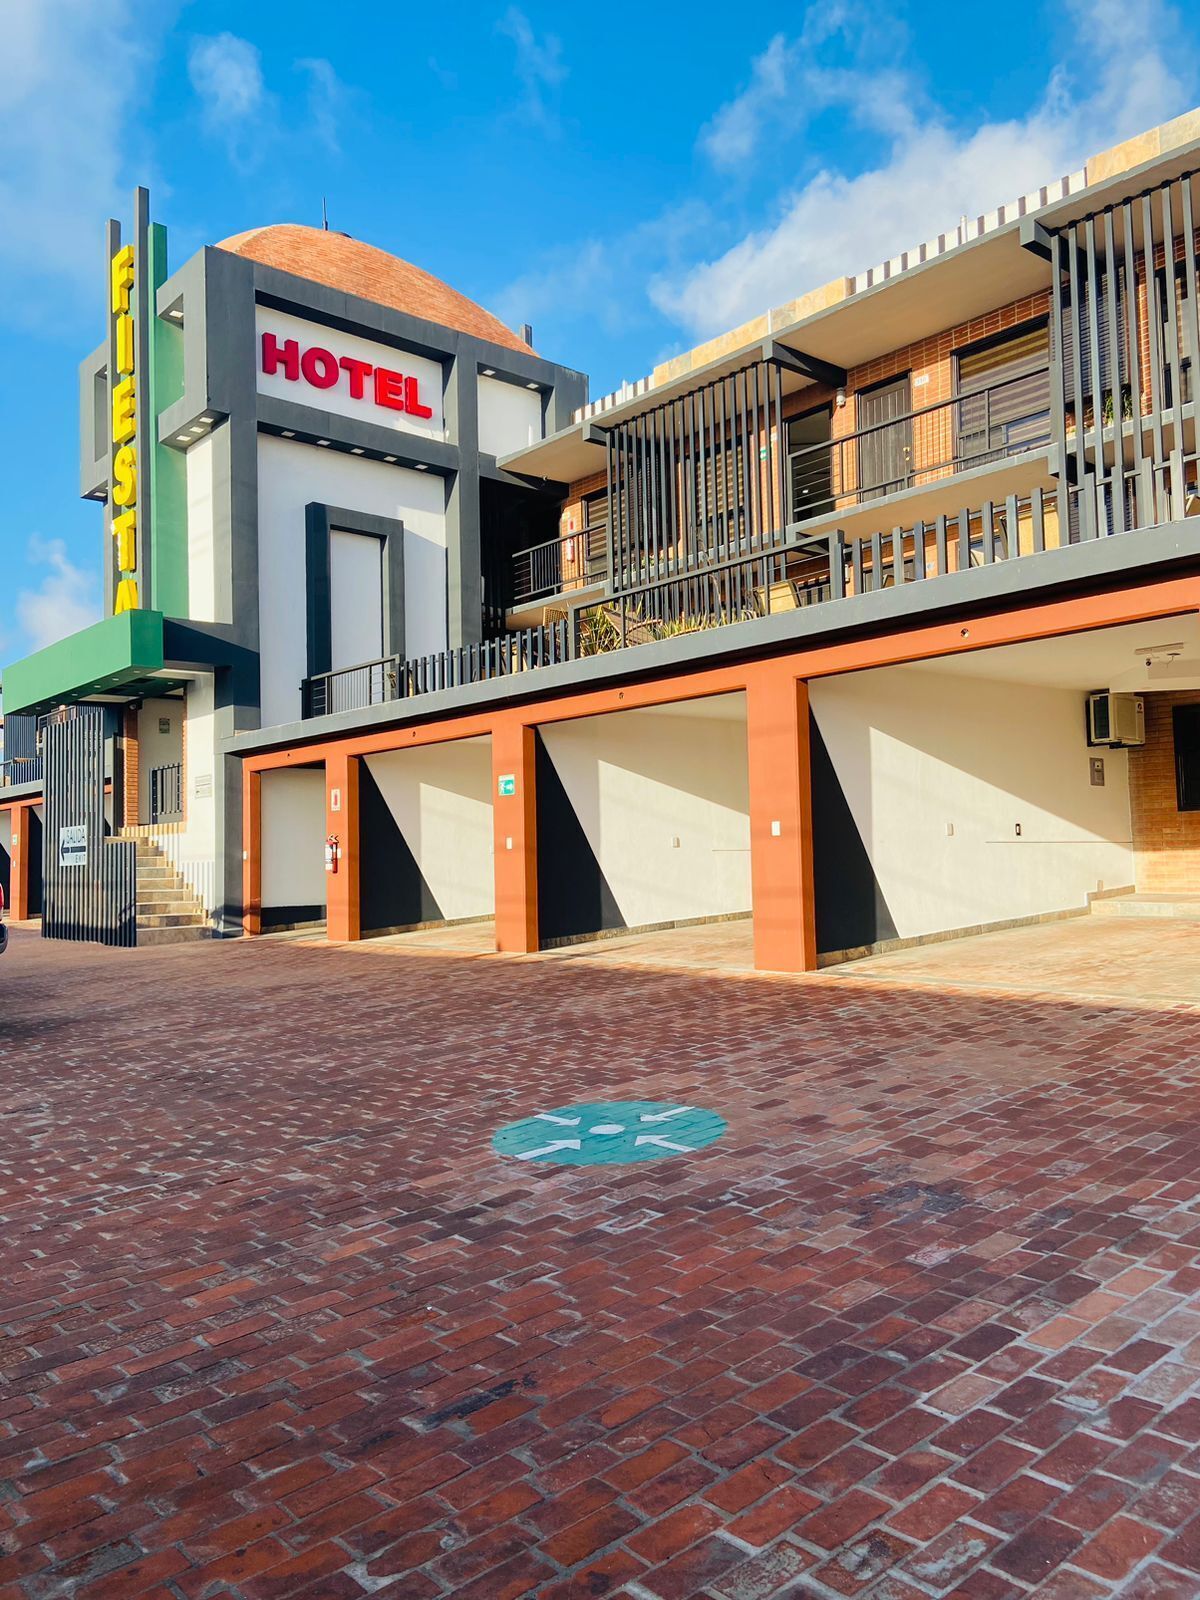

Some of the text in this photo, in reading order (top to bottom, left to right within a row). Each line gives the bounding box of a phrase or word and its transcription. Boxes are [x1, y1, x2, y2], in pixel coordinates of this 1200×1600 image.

[261, 332, 433, 419] HOTEL
[111, 245, 138, 616] FIESTA
[66, 828, 87, 844] SALIDA
